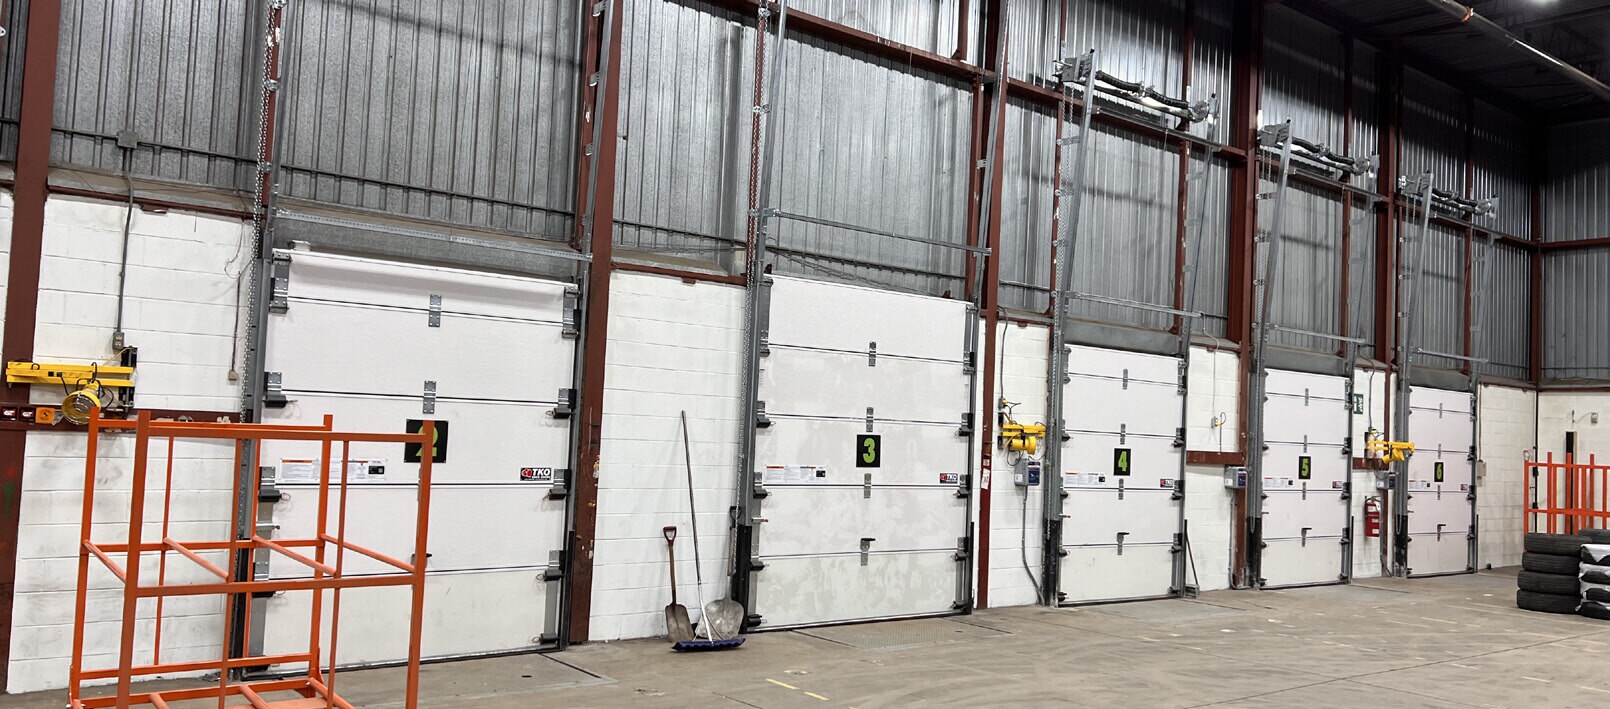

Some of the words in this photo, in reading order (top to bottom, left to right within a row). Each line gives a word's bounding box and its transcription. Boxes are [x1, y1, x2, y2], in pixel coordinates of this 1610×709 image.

[863, 437, 875, 463] 3
[1118, 450, 1128, 472] 4
[1301, 458, 1309, 477] 5
[532, 468, 551, 476] TKO
[1436, 463, 1442, 480] 6
